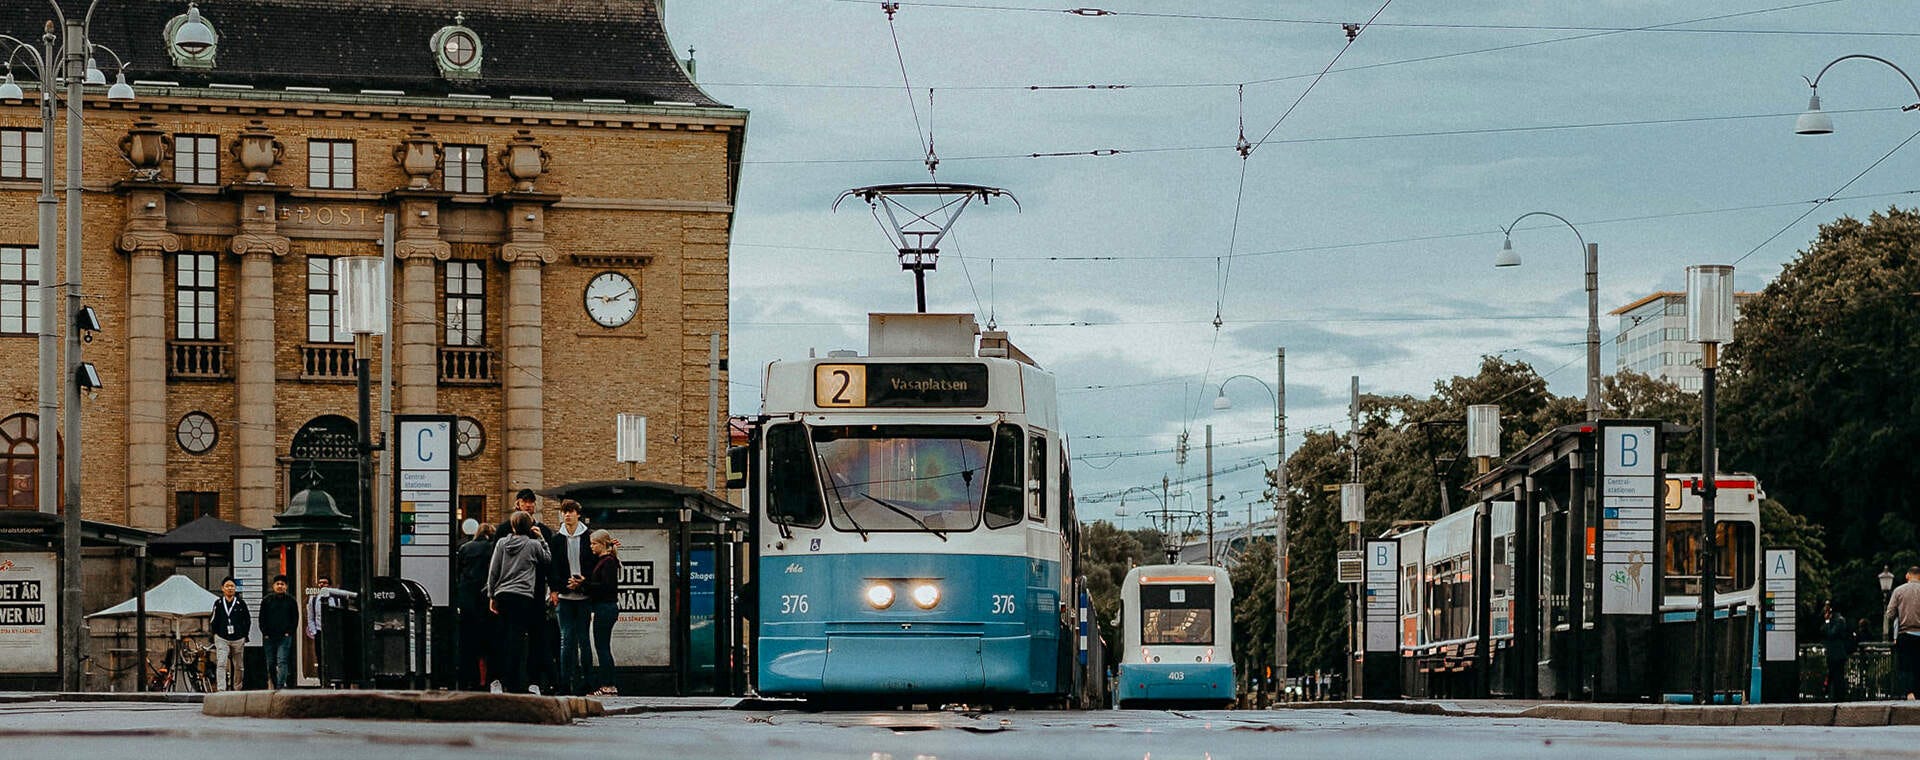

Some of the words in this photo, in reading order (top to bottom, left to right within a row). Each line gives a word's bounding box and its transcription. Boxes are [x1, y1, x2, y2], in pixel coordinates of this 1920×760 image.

[297, 206, 369, 225] POST
[832, 369, 851, 404] 2
[891, 378, 968, 392] Vasaplatsen
[418, 428, 433, 462] C
[1620, 433, 1638, 467] B
[242, 542, 253, 563] D
[1377, 546, 1388, 566] B
[1774, 554, 1787, 575] A
[21, 581, 39, 600] ÄR
[781, 594, 809, 614] 376
[991, 594, 1015, 614] 376
[26, 607, 44, 623] NU
[1168, 671, 1185, 680] 403
